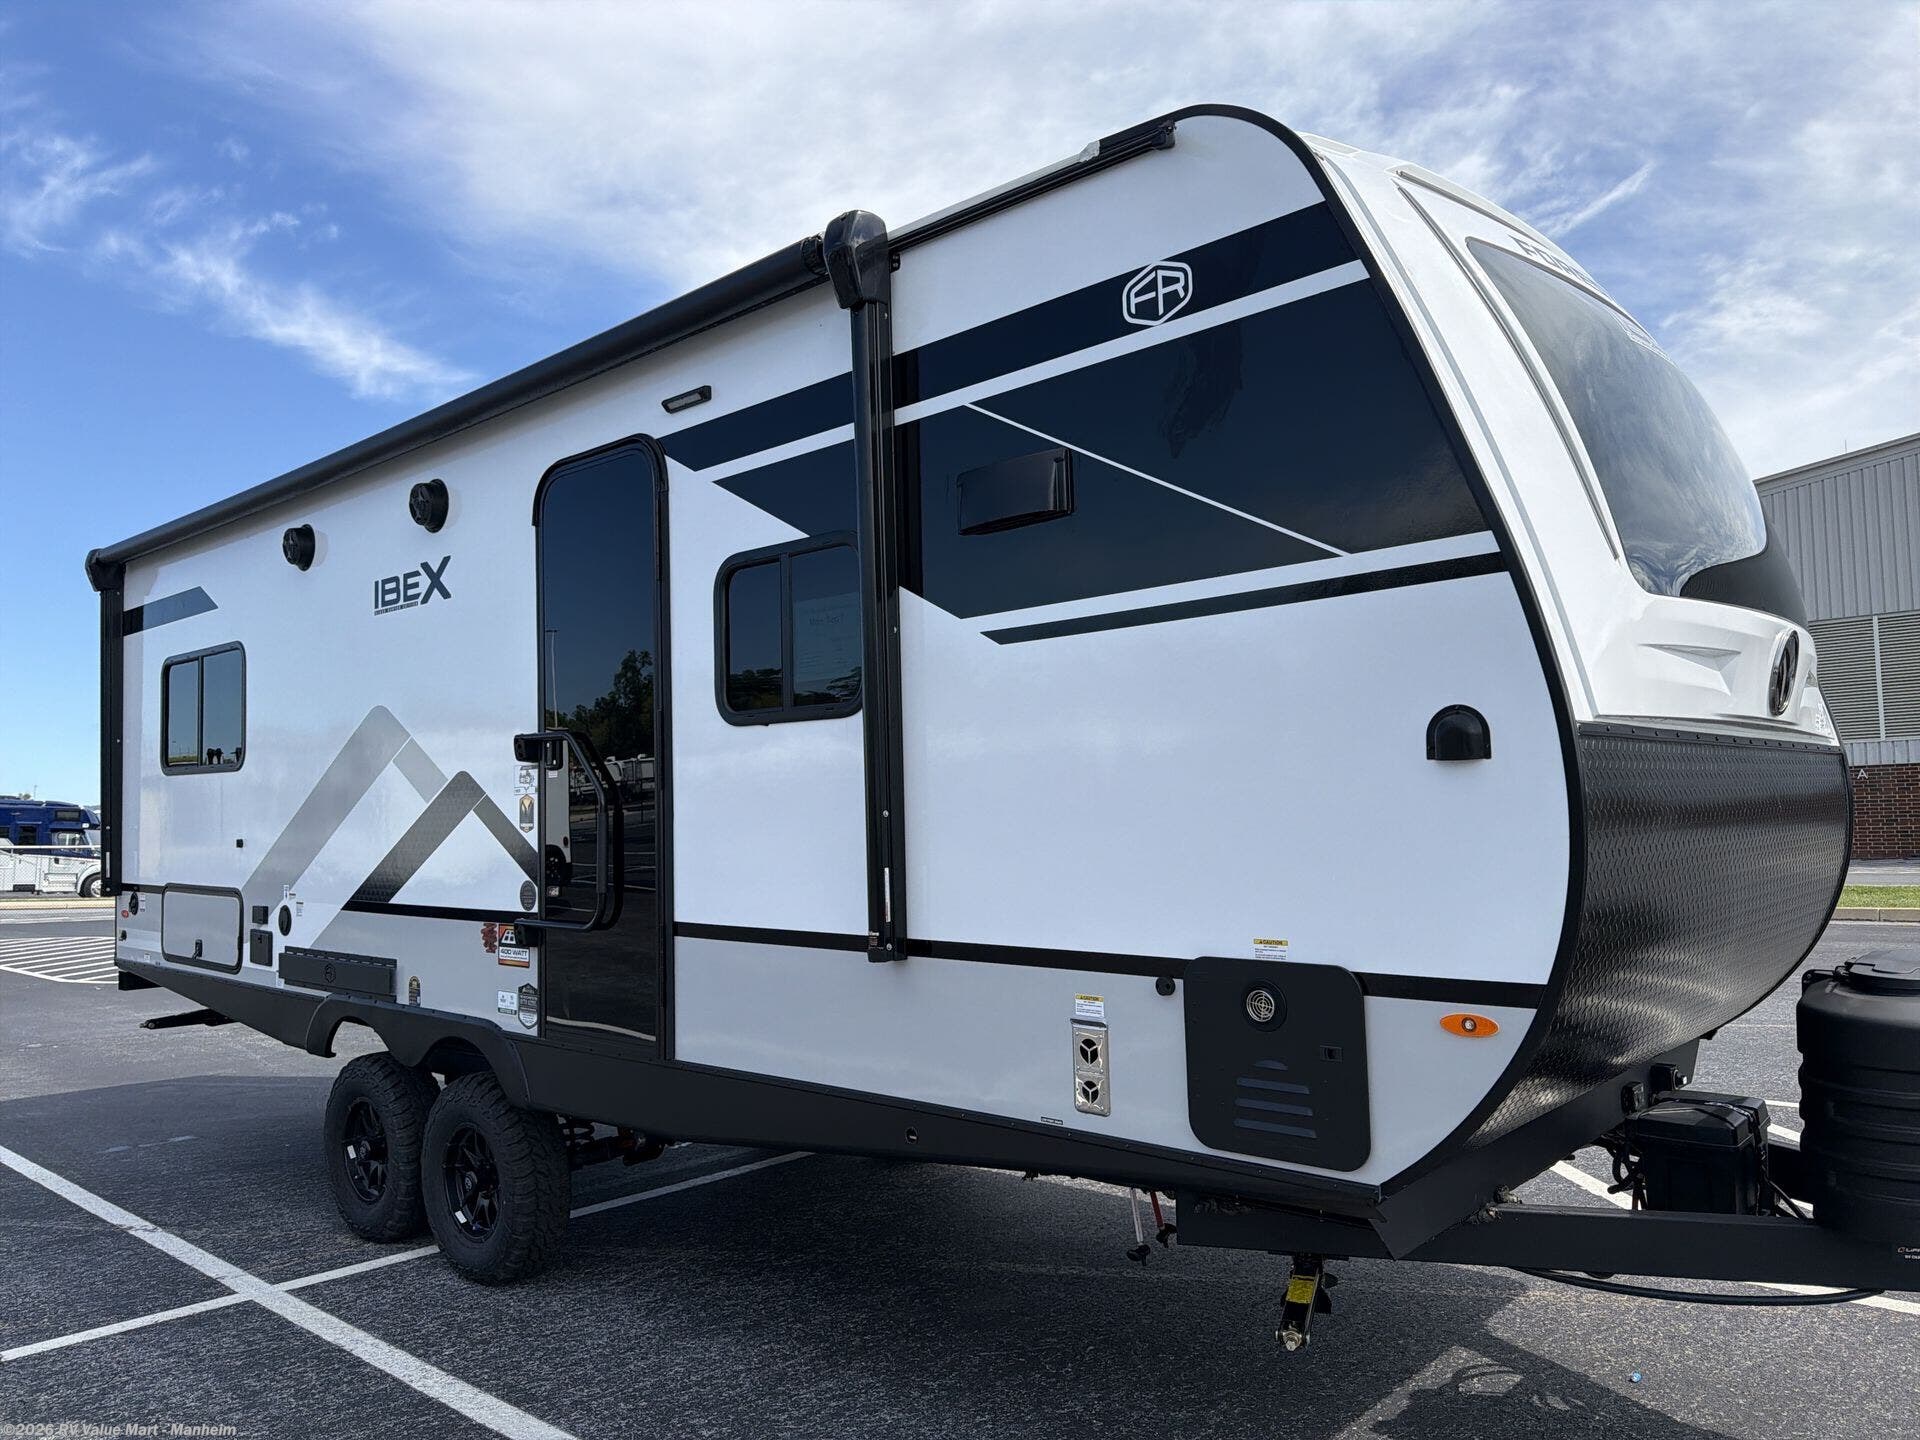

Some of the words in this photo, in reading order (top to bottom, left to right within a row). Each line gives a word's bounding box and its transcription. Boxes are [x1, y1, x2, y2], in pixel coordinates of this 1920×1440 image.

[374, 555, 452, 610] IBEX
[1857, 768, 1868, 779] A
[512, 949, 528, 957] WATT
